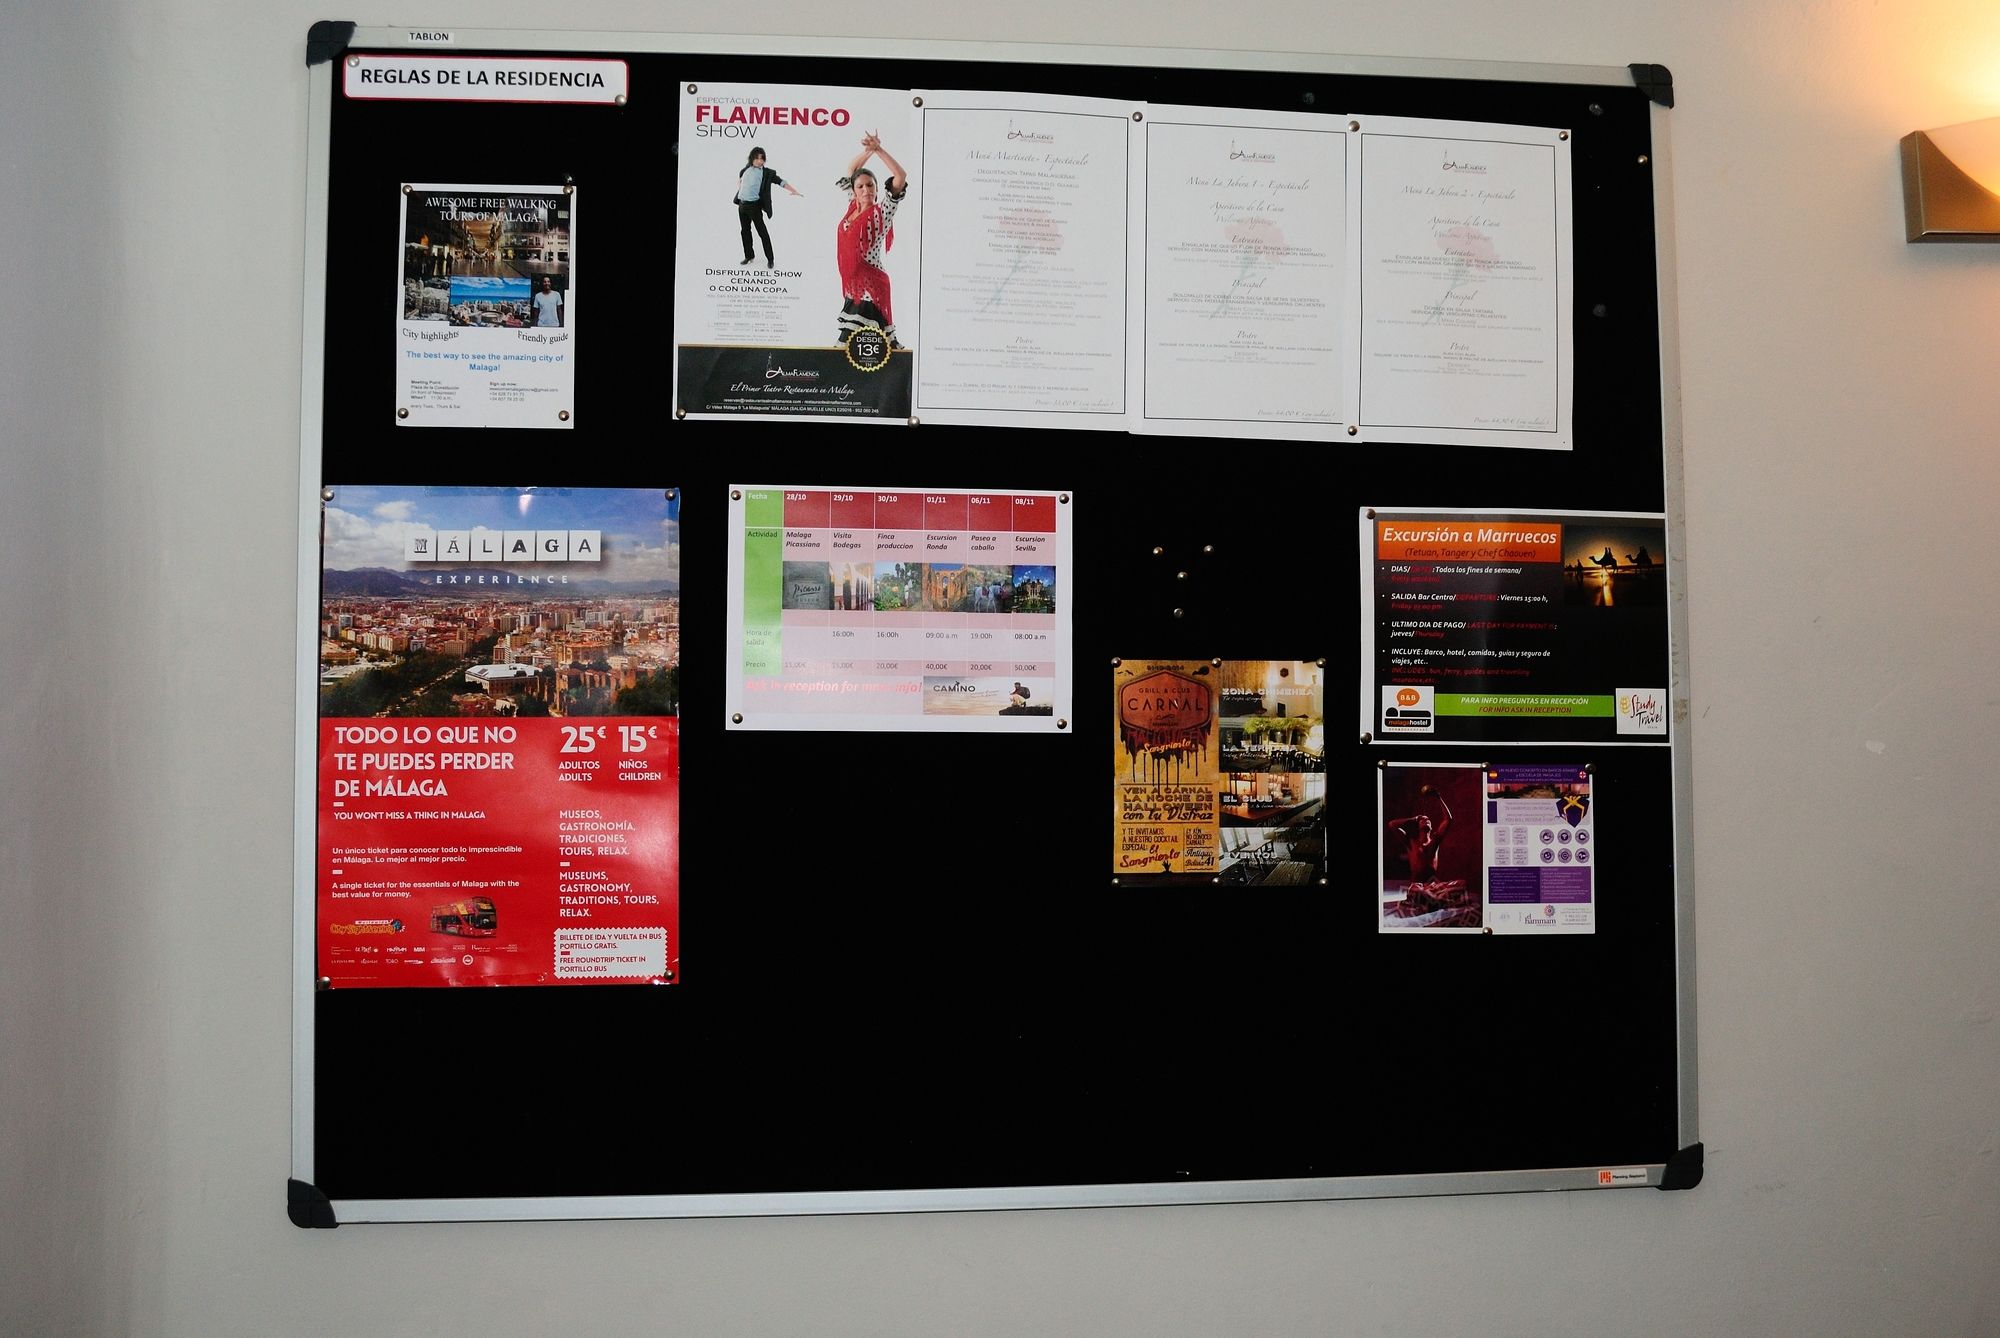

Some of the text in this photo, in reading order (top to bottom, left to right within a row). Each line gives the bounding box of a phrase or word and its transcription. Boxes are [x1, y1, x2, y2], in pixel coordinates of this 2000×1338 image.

[409, 32, 449, 42] TABLON
[361, 69, 605, 87] REGLAS DE LA RESIDENCIA
[696, 97, 760, 105] ESPECTÁCULO
[696, 105, 850, 127] FLAMENCO
[696, 125, 758, 139] SHOW
[425, 197, 556, 210] AWESOME FREE WALKING
[440, 210, 475, 221] TOURS
[476, 211, 490, 221] OF
[705, 268, 751, 277] DISFRUTA
[774, 270, 802, 278] SHOW
[730, 277, 777, 285] CENANDO
[718, 285, 736, 293] CON
[763, 286, 788, 294] COPA
[402, 327, 460, 341] City highlights
[517, 330, 569, 345] Friendly guide
[856, 336, 883, 344] DESDE
[856, 344, 880, 357] 13€
[406, 350, 421, 359] The
[423, 351, 441, 359] best
[443, 353, 459, 361] way
[461, 352, 470, 360] to
[488, 352, 501, 361] the
[503, 353, 537, 363] amazing
[539, 354, 553, 363] city
[555, 354, 564, 362] of
[469, 363, 501, 373] Malaga!
[730, 384, 741, 393] El
[742, 385, 762, 394] Primer
[763, 385, 782, 394] Teatro
[783, 385, 819, 395] Restaurante
[828, 383, 855, 400] Málaga
[786, 493, 807, 501] 28/10
[833, 494, 853, 502] 29/10
[926, 496, 947, 504] 01/11
[747, 531, 778, 539] Actividad
[1383, 527, 1557, 544] Excursión a Marruecos
[414, 534, 592, 554] MÁLAGA
[876, 542, 914, 550] produccion
[1405, 547, 1536, 559] (Tetuan, Tanger Chef Chaouen)
[436, 575, 569, 585] EXPERIENCE
[1417, 593, 1431, 601] Bar
[1418, 621, 1433, 629] DIA
[1432, 621, 1444, 629] DE
[1443, 621, 1467, 630] PAGO/
[1391, 648, 1551, 659] INCLUYE: Barco, hotel, comidas, seguro de
[1391, 657, 1412, 666] viajes,
[1015, 664, 1037, 672] 50,00€
[933, 681, 976, 693] CAMINO
[1222, 688, 1254, 696] ZONA
[1128, 698, 1204, 711] CARNAL
[1461, 697, 1480, 705] PARA
[1481, 697, 1498, 705] INFO
[1498, 697, 1539, 705] PREGUNTAS
[1550, 696, 1589, 705] RECEPCIÓN
[1630, 694, 1656, 718] Study
[1636, 705, 1663, 729] Travel
[334, 726, 517, 745] TODO LO QUE NO
[560, 725, 657, 753] 25€ 15€
[334, 752, 514, 770] TE PUEDES PERDER
[558, 758, 648, 770] ADULTOS NIÑOS
[558, 772, 661, 782] ADULTS CHILDREN
[334, 775, 448, 797] DE MÁLAGA
[1147, 794, 1191, 802] NOCHE
[1195, 794, 1213, 802] DE
[1123, 803, 1213, 812] HALLOWEEN
[334, 811, 486, 820] YOU WON'T MISS A THING IN MALAGA
[560, 810, 602, 820] MUSEOS,
[559, 820, 636, 832] GASTRONOMÍA,
[559, 834, 627, 845] TRADICIONES,
[559, 846, 630, 857] TOURS, RELAX.
